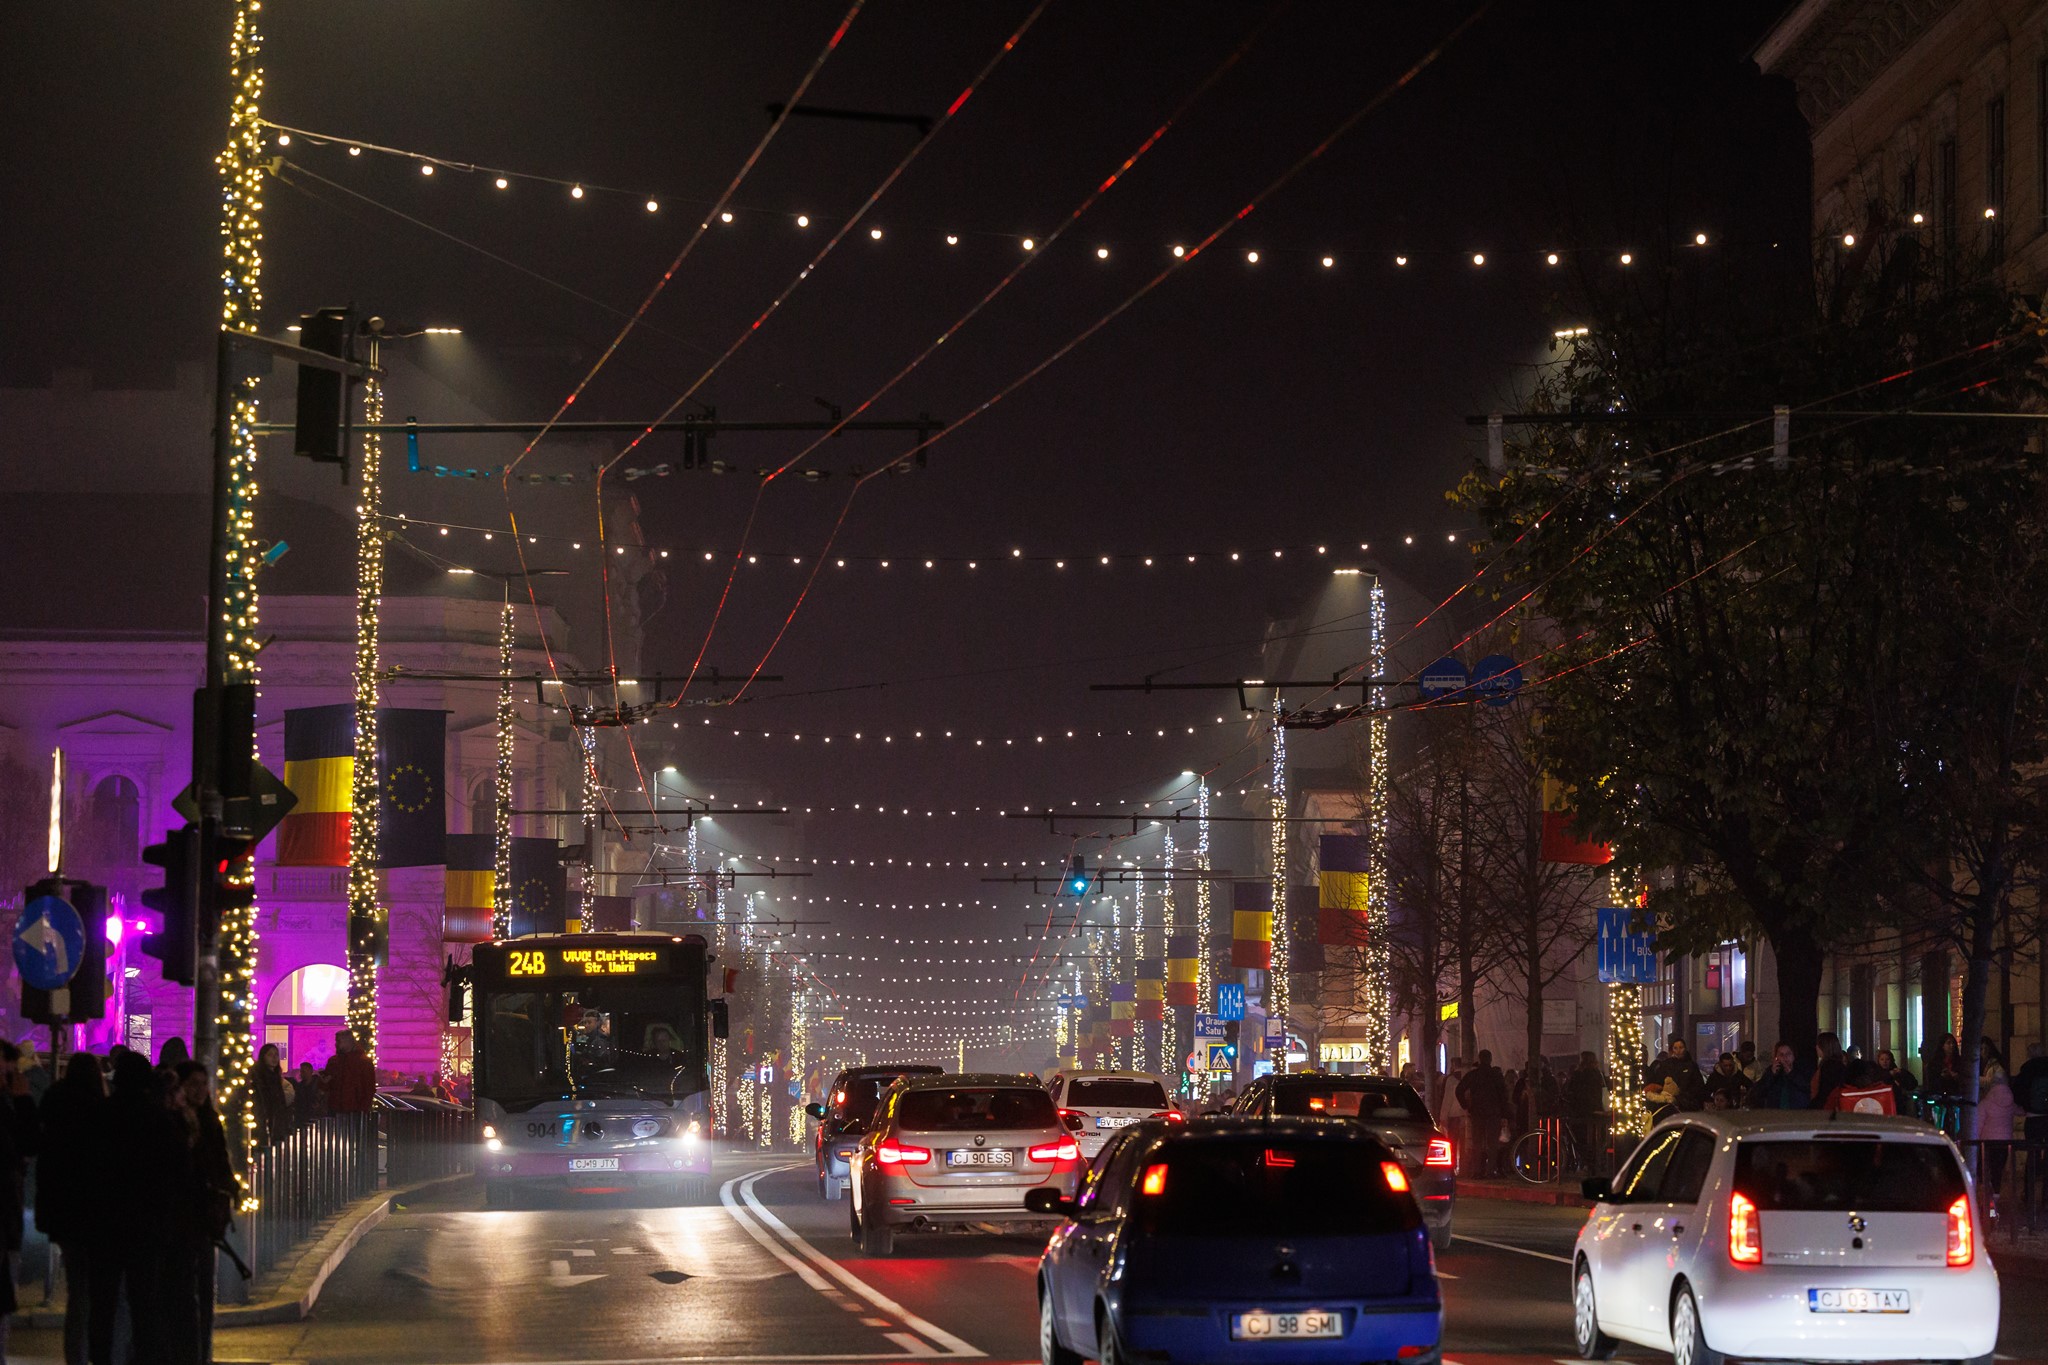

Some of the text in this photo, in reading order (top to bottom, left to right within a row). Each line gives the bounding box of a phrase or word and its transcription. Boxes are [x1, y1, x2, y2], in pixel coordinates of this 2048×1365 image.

[563, 950, 657, 962] VIVO! Cluj-Napoca
[1637, 947, 1653, 956] BUS
[510, 952, 546, 975] 24B
[585, 962, 635, 973] Str. Unirii
[1205, 1026, 1222, 1035] Satu
[527, 1122, 557, 1138] 904
[600, 1158, 616, 1168] JTX
[1874, 1292, 1903, 1308] TAY
[1247, 1315, 1336, 1335] CJ 98 SMI
